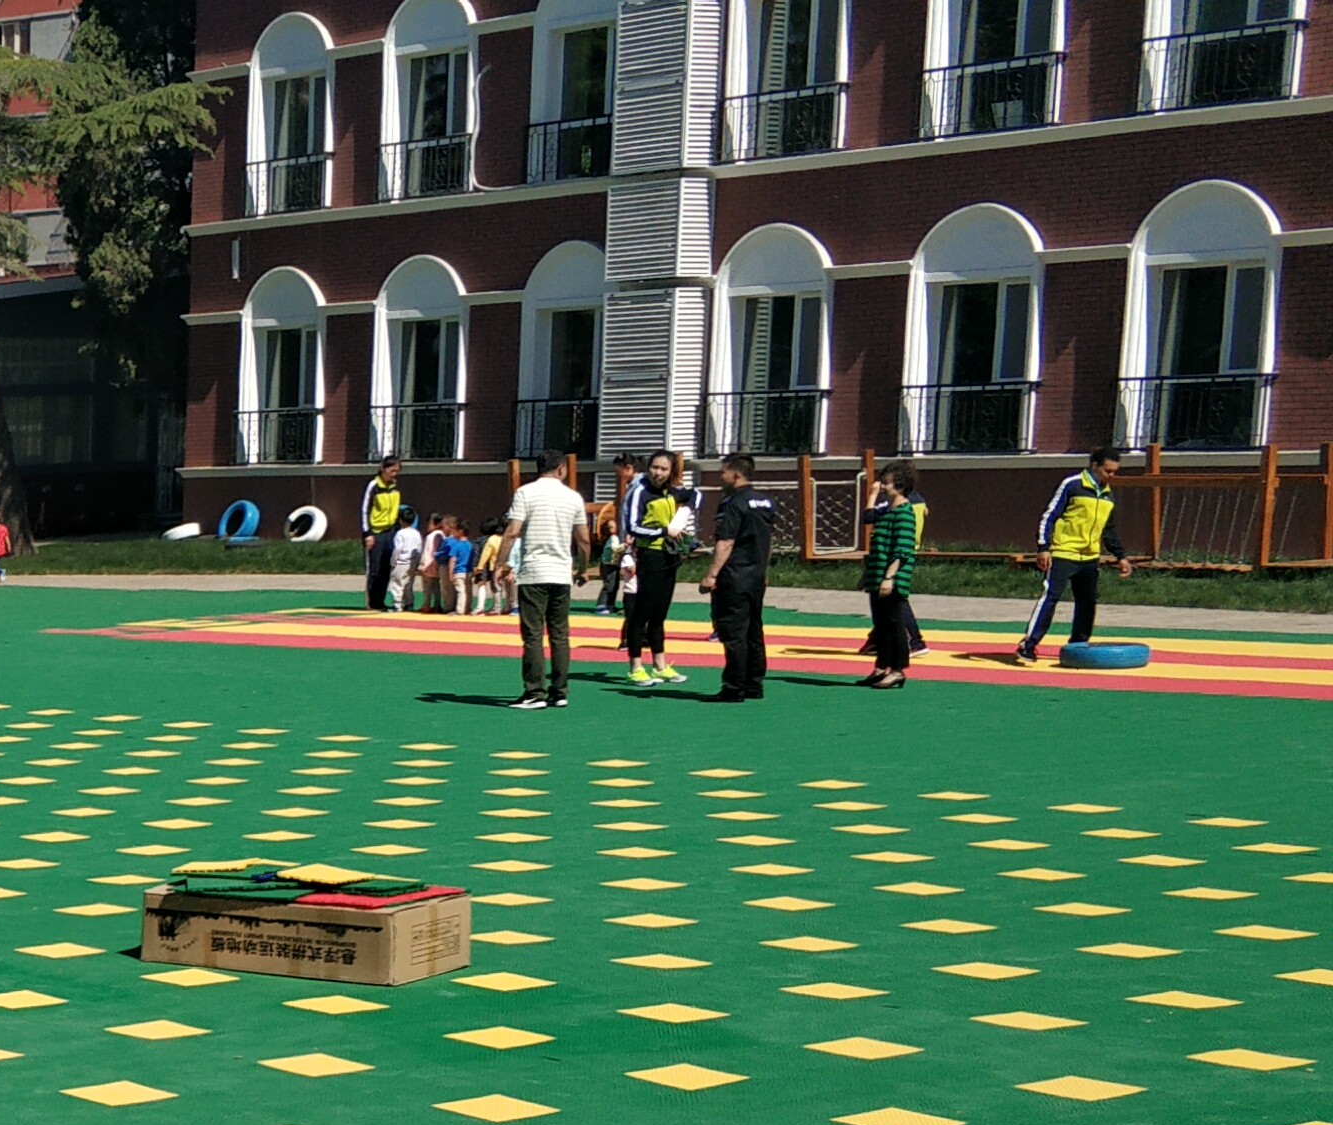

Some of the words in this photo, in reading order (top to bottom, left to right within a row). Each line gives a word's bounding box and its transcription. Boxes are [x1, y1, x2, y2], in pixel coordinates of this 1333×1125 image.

[210, 936, 358, 965] 悬浮式拼装运动地板
